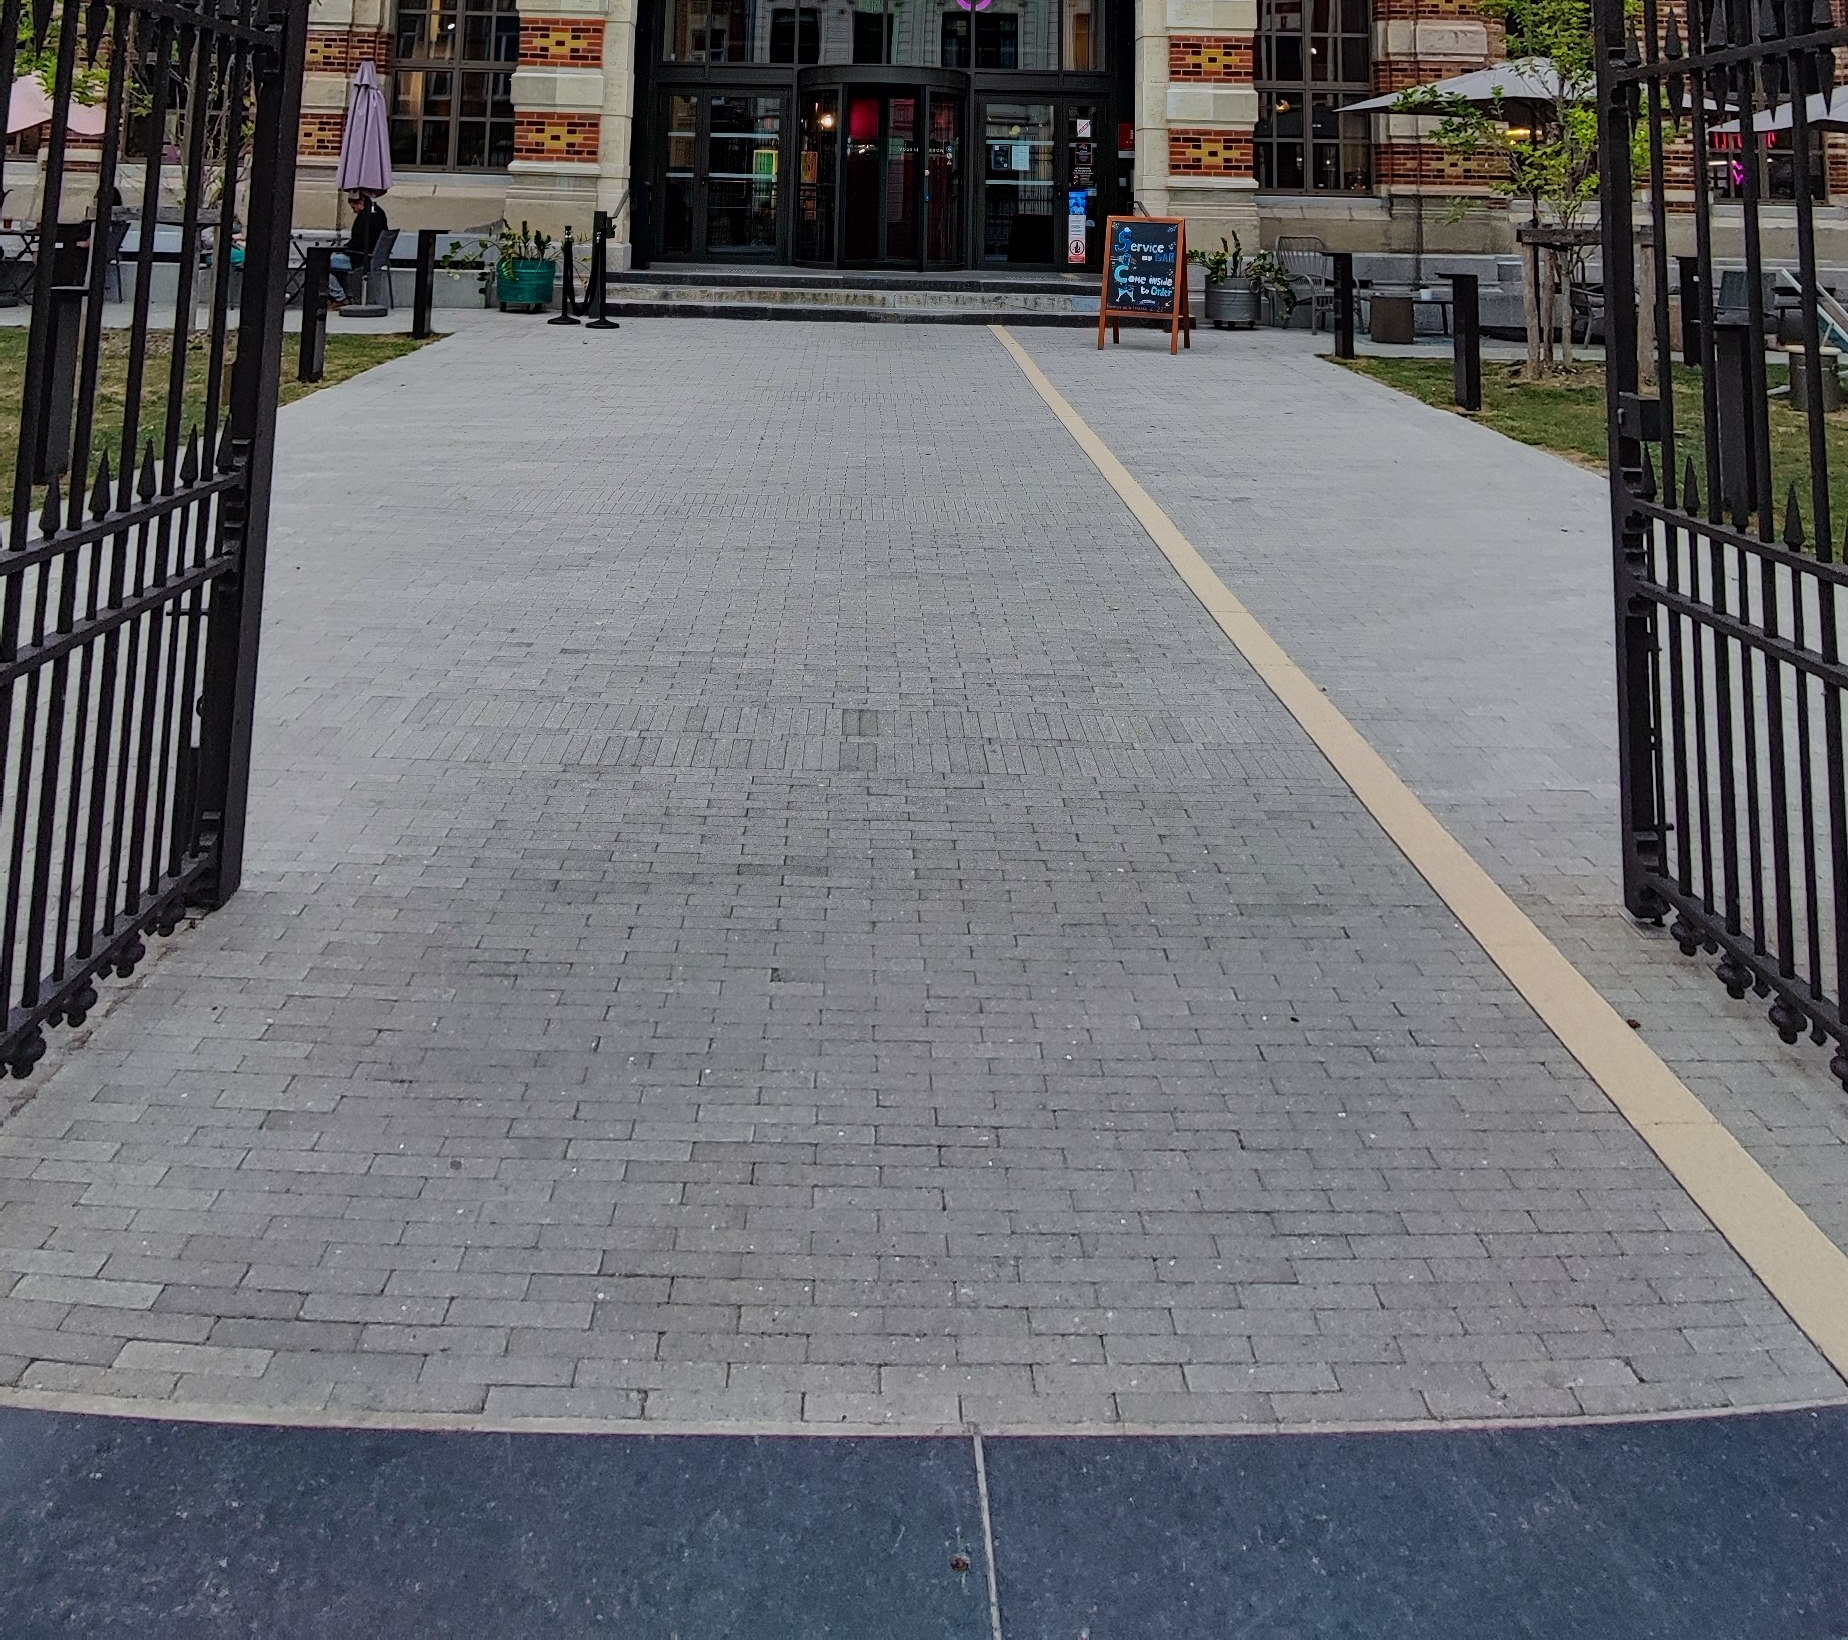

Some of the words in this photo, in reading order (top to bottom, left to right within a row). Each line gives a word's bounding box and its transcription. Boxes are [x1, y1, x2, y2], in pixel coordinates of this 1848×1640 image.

[1114, 228, 1165, 253] Service
[1114, 264, 1147, 285] Come
[1148, 274, 1173, 286] inside
[1140, 286, 1149, 294] to
[1150, 286, 1173, 297] Order
